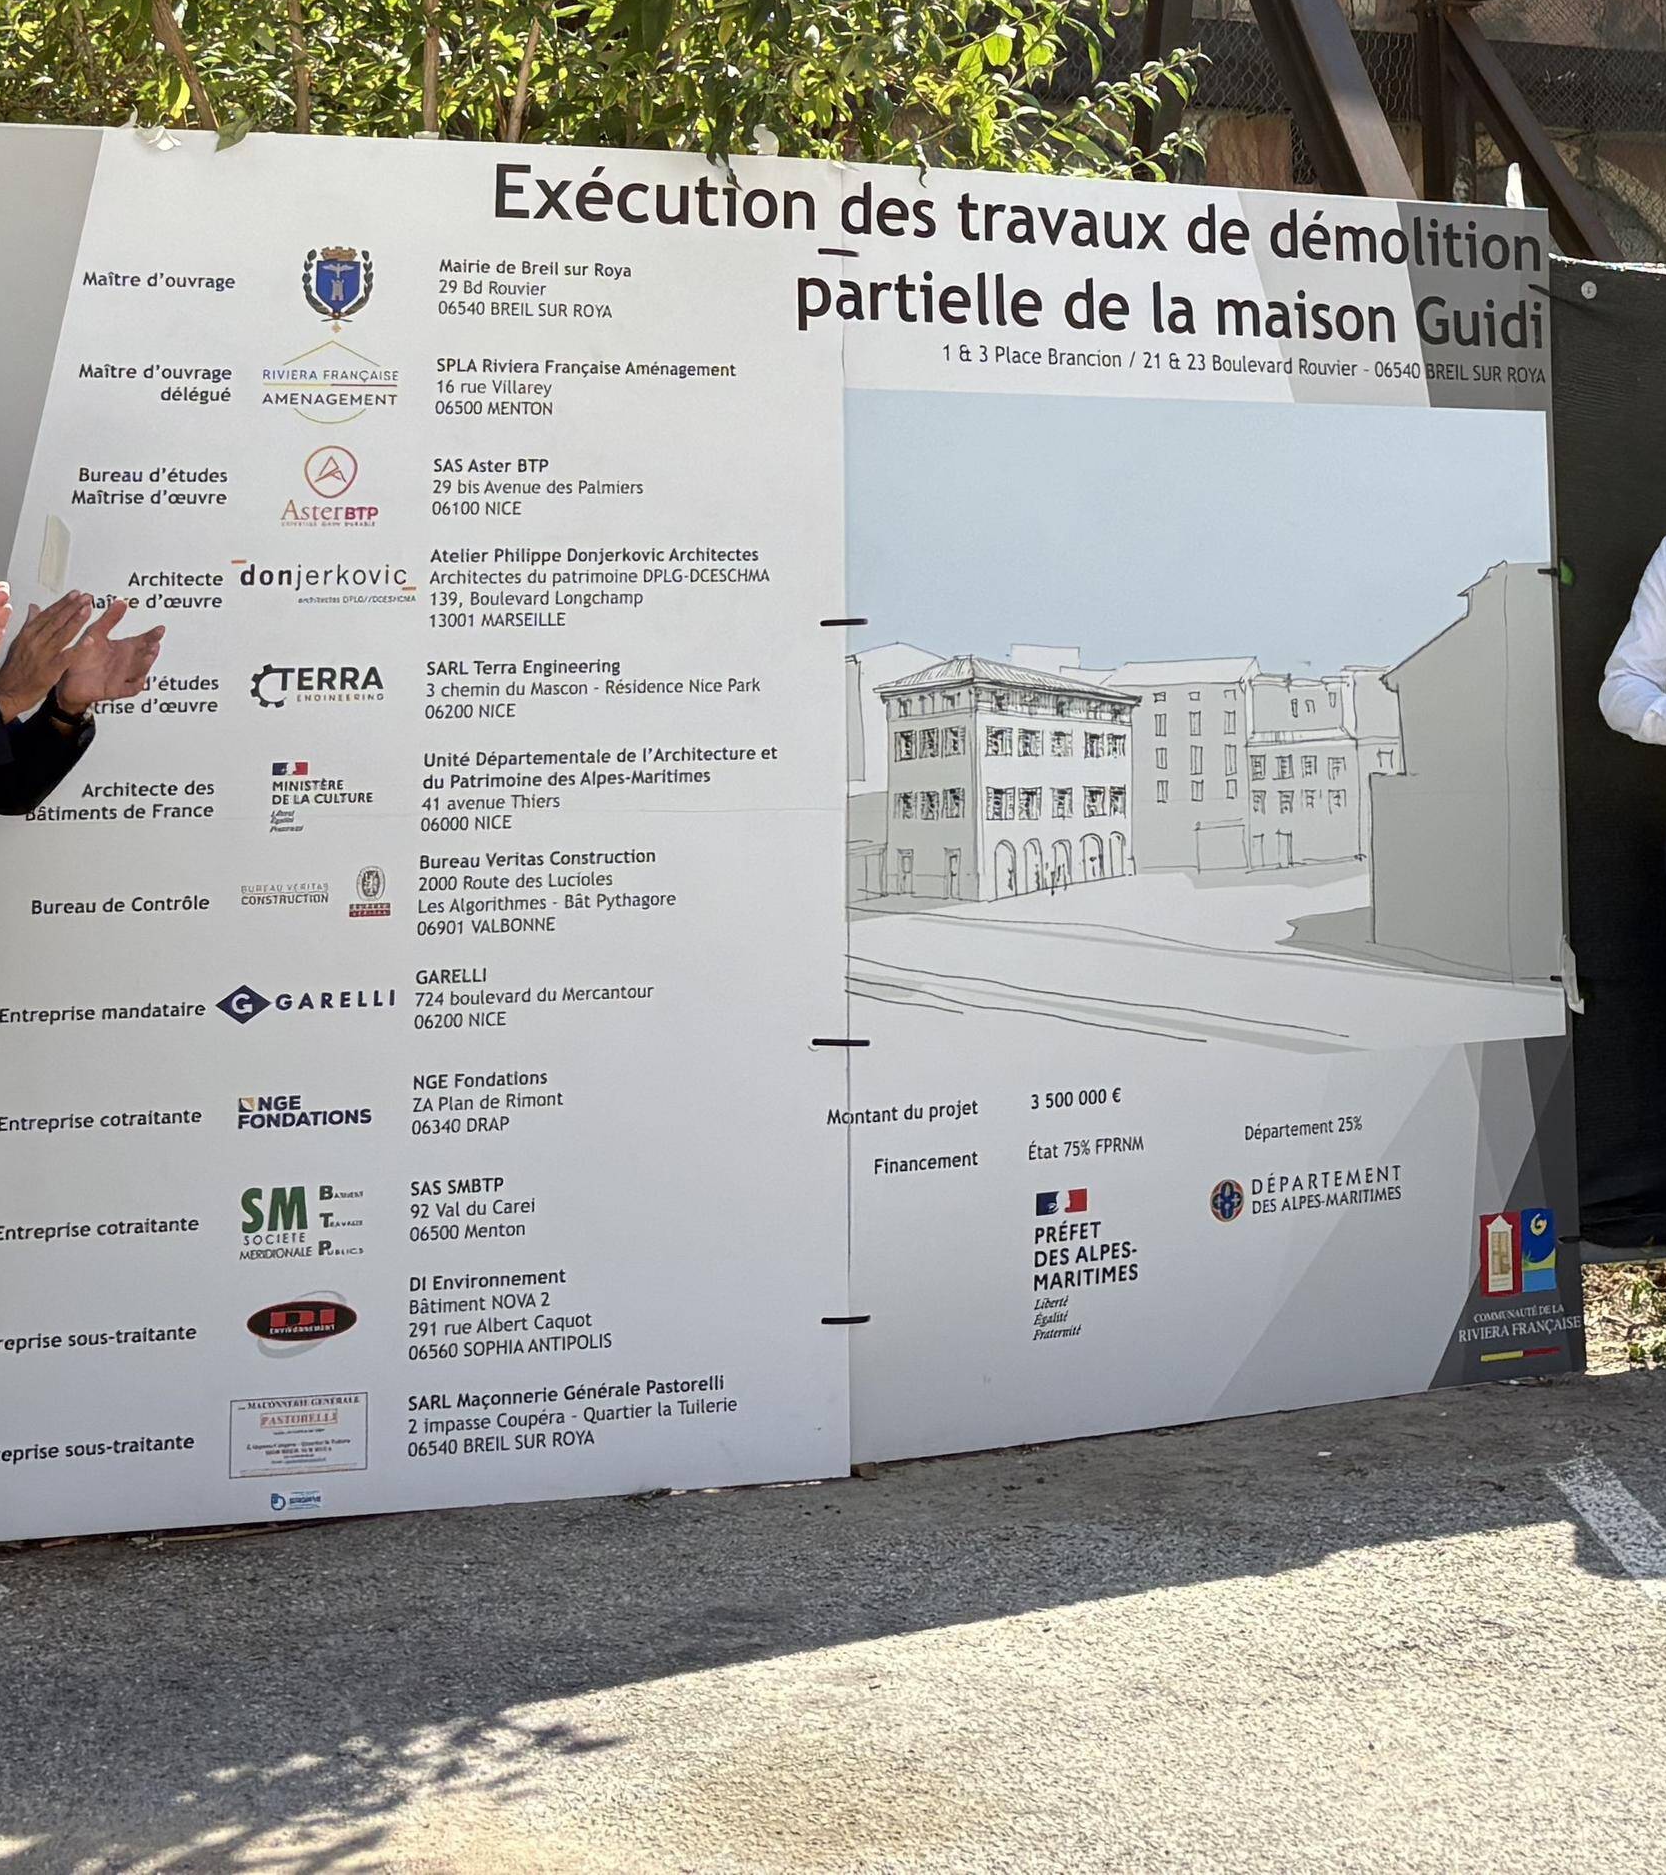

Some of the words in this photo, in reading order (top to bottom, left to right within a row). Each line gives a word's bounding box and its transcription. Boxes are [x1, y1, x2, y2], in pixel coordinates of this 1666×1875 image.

[494, 163, 816, 231] Exécution
[841, 181, 937, 239] des
[957, 192, 1168, 252] travaux
[1187, 202, 1250, 256] de
[1270, 207, 1542, 273] démolition
[439, 258, 491, 274] Mairie
[495, 259, 517, 275] de
[521, 260, 559, 276] Breil
[564, 264, 589, 277] sur
[594, 262, 632, 281] Roya
[82, 271, 142, 287] Maître
[146, 272, 236, 293] d'ouvrage
[438, 300, 486, 316] 06540
[490, 301, 534, 317] BREIL
[537, 302, 568, 318] SUR
[573, 303, 613, 319] ROYA
[797, 271, 1043, 332] partielle
[1064, 277, 1130, 332] de
[1152, 280, 1196, 335] la
[1217, 289, 1396, 343] maison
[1415, 295, 1543, 349] Guidi
[78, 363, 138, 379] Maître
[142, 364, 233, 384] d'ouvrage
[436, 357, 478, 373] SPLA
[482, 358, 540, 374] Riviera
[545, 359, 622, 379] Française
[624, 361, 737, 380] Aménagement
[942, 344, 950, 362] 1
[959, 343, 973, 363] &
[979, 344, 989, 363] 3
[995, 345, 1042, 365] Place
[1047, 347, 1122, 368] Brancion
[1128, 350, 1136, 368] /
[1142, 351, 1161, 370] 21
[1168, 352, 1182, 370] &
[1186, 352, 1206, 371] 23
[1212, 354, 1293, 375] Boulevard
[1298, 357, 1359, 377] Rouvier
[1374, 360, 1421, 380] 06540
[1426, 363, 1470, 383] BREIL
[1472, 364, 1502, 383] SUR
[1507, 366, 1546, 384] ROYA
[261, 368, 318, 382] RIVIERA
[323, 369, 399, 384] FRANÇAISE
[160, 386, 232, 405] délégué
[261, 392, 398, 406] AMENAGEMENT
[78, 467, 143, 483] Bureau
[148, 467, 228, 483] d'études
[433, 458, 464, 473] SAS
[467, 458, 512, 473] Aster
[517, 458, 549, 473] BTP
[71, 489, 145, 505] Maîtrise
[150, 489, 228, 505] d'œuvre
[429, 548, 489, 564] Atelier
[494, 547, 562, 566] Philippe
[567, 547, 665, 566] Donjerkovic
[668, 546, 759, 562] Architectes
[127, 570, 224, 587] Architecte
[239, 563, 408, 592] donjerkovic
[276, 666, 384, 692] TERRA
[423, 751, 471, 768] Unité
[475, 748, 612, 770] Départementale
[616, 747, 637, 763] de
[642, 746, 757, 763] l'Architecture
[760, 746, 778, 760] et
[81, 781, 179, 798] Architecte
[184, 779, 215, 796] des
[271, 778, 344, 792] MINISTÈRE
[271, 794, 290, 806] DE
[292, 794, 311, 805] LA
[313, 792, 374, 805] CULTURE
[123, 803, 146, 820] de
[152, 803, 214, 819] France
[419, 854, 480, 870] Bureau
[485, 851, 545, 868] Veritas
[549, 848, 656, 866] Construction
[31, 899, 97, 915] Bureau
[102, 897, 126, 913] de
[131, 894, 210, 912] Contrôle
[240, 892, 330, 906] CONSTRUCTION
[415, 967, 487, 985] GARELLI
[101, 1001, 207, 1020] mandataire
[275, 989, 396, 1012] GARELLI
[413, 1073, 449, 1091] NGE
[454, 1070, 548, 1089] Fondations
[257, 1095, 302, 1112] NGE
[1030, 1093, 1040, 1110] 3
[1045, 1091, 1074, 1109] 500
[1078, 1088, 1107, 1106] 000
[1111, 1087, 1122, 1104] €
[99, 1109, 203, 1128] cotraitante
[237, 1108, 373, 1130] FONDATIONS
[826, 1106, 899, 1129] Montant
[903, 1103, 924, 1121] du
[928, 1099, 979, 1123] projet
[1244, 1119, 1334, 1143] Département
[1337, 1115, 1363, 1133] 25%
[1028, 1140, 1059, 1161] État
[1063, 1139, 1091, 1158] 75%
[1095, 1135, 1145, 1155] FPRNM
[874, 1151, 979, 1175] Financement
[1251, 1164, 1402, 1196] DÉPARTEMENT
[240, 1185, 309, 1234] SM
[1251, 1198, 1277, 1215] DES
[1280, 1185, 1402, 1212] ALPES-MARITIMES
[96, 1217, 200, 1236] cotraitante
[1034, 1220, 1102, 1245] PRÉFET
[243, 1232, 306, 1246] SOCIETE
[238, 1246, 313, 1261] MERIDIONALE
[1034, 1247, 1070, 1268] DES
[1074, 1240, 1138, 1264] ALPES-
[409, 1276, 427, 1292] DI
[432, 1268, 567, 1291] Environnement
[1033, 1263, 1139, 1291] MARITIMES
[1473, 1304, 1538, 1324] COMMUNAUTÉ
[1538, 1304, 1552, 1315] DE
[1552, 1303, 1565, 1314] LA
[68, 1326, 197, 1347] sous-traitante
[1458, 1324, 1510, 1343] RIVIERA
[1511, 1315, 1582, 1335] FRANÇAISE
[408, 1393, 452, 1412] SARL
[456, 1386, 559, 1411] Maçonnerie
[563, 1380, 641, 1401] Générale
[646, 1374, 724, 1396] Pastorelli
[65, 1435, 195, 1458] sous-traitante
